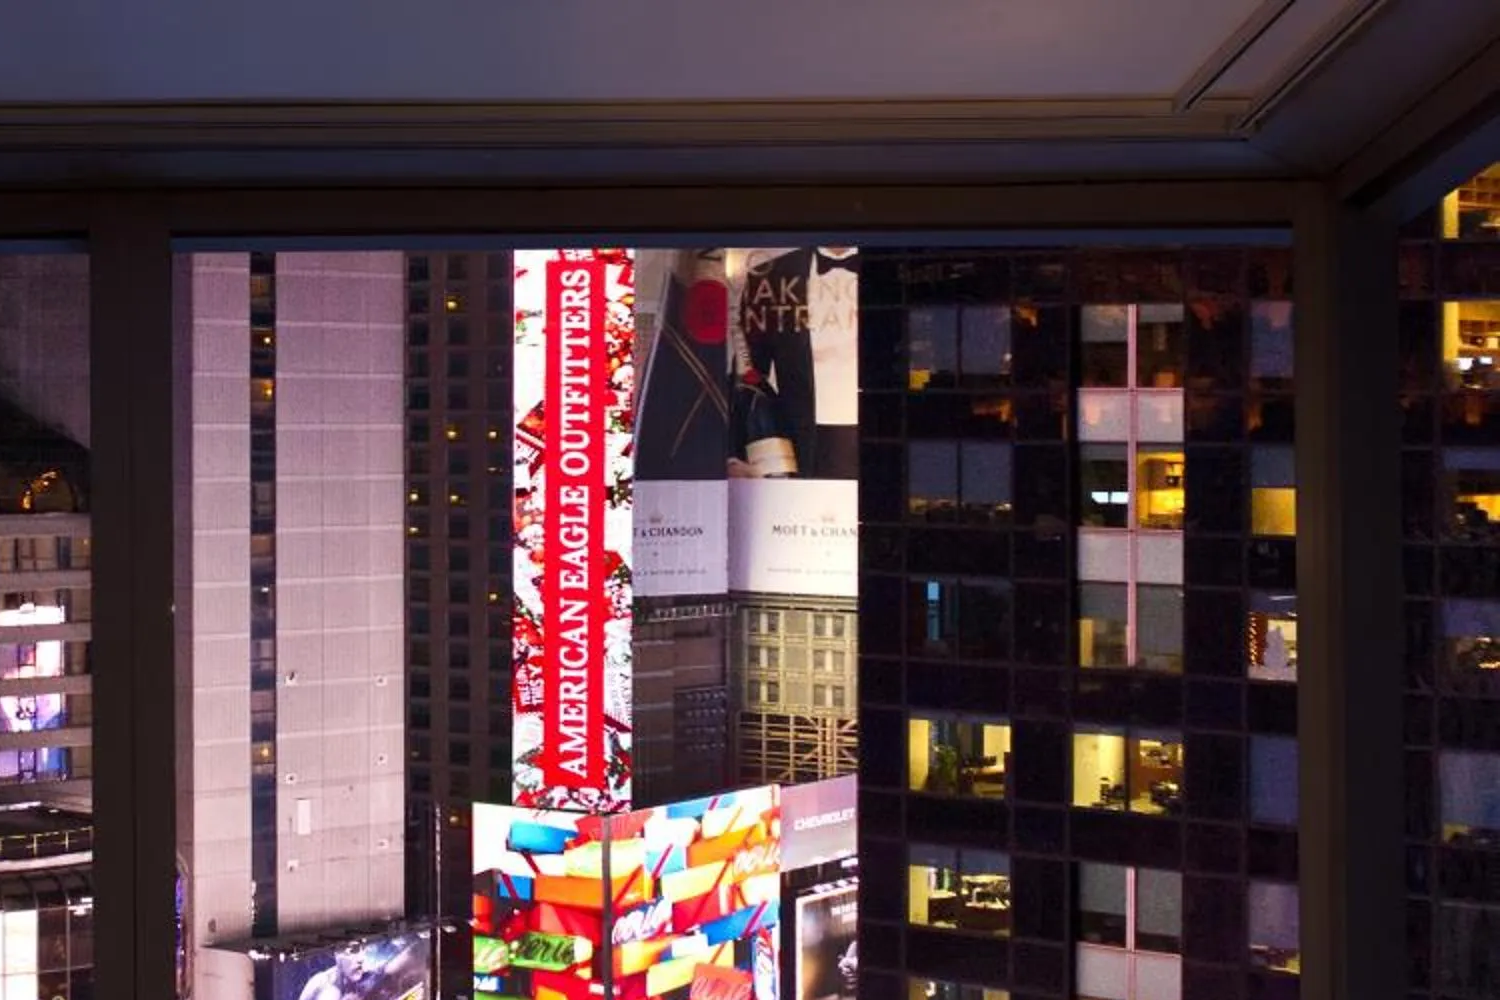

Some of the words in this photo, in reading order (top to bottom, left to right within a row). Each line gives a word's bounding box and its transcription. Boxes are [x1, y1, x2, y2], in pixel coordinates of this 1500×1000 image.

[560, 269, 592, 476] OUTFITTERS
[559, 486, 590, 590] EAGLE
[649, 526, 704, 537] CHANDON
[558, 598, 590, 778] AMERICAN
